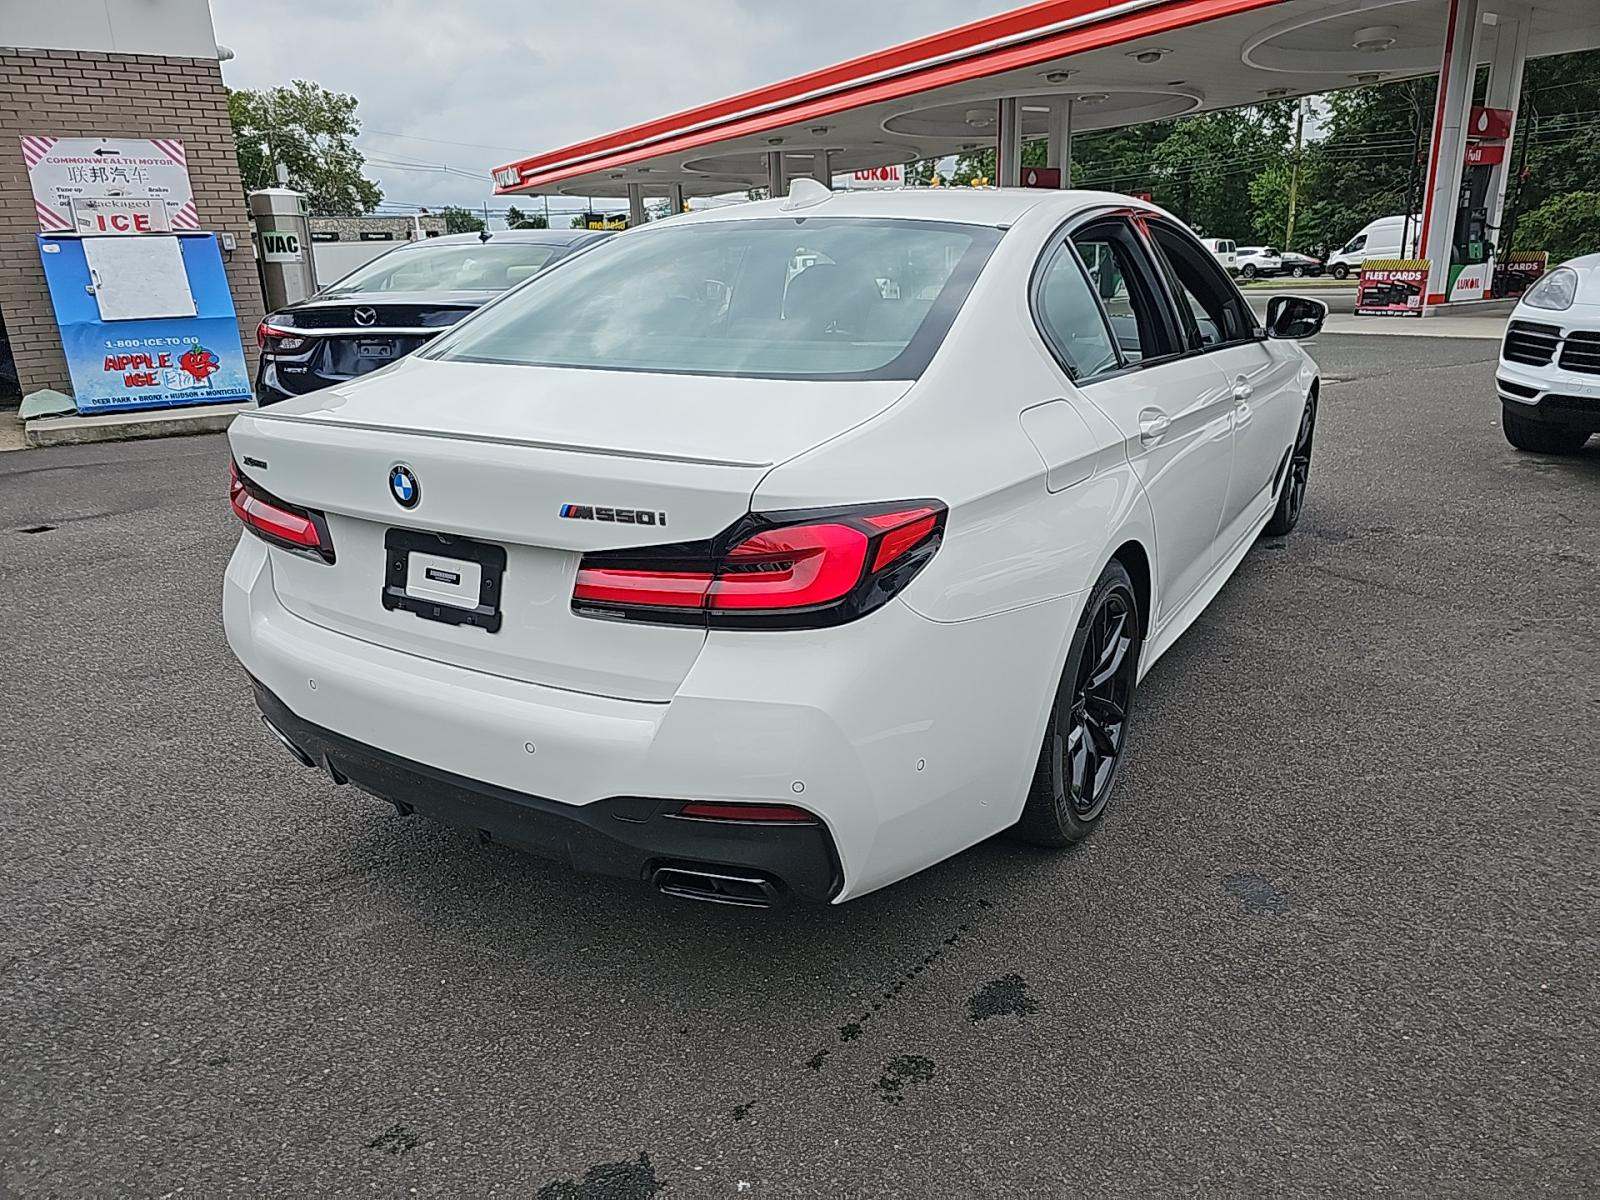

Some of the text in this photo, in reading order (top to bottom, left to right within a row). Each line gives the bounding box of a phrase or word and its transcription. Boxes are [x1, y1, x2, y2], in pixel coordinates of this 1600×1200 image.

[46, 157, 174, 166] COMMONWEALTH MOTOR
[67, 166, 150, 184] 联邦汽车
[854, 165, 900, 181] LUKOIL
[96, 213, 151, 232] ICE
[263, 235, 299, 254] VAC
[1507, 262, 1539, 271] CARDS
[1365, 271, 1422, 281] FLEET CARDS
[1456, 278, 1480, 290] LUKOIL
[104, 351, 174, 371] APPLE
[123, 371, 161, 388] ICE
[111, 396, 131, 405] PARK
[138, 394, 162, 402] BRONX
[170, 391, 199, 399] HUDSON
[205, 388, 247, 397] MONTICELLO
